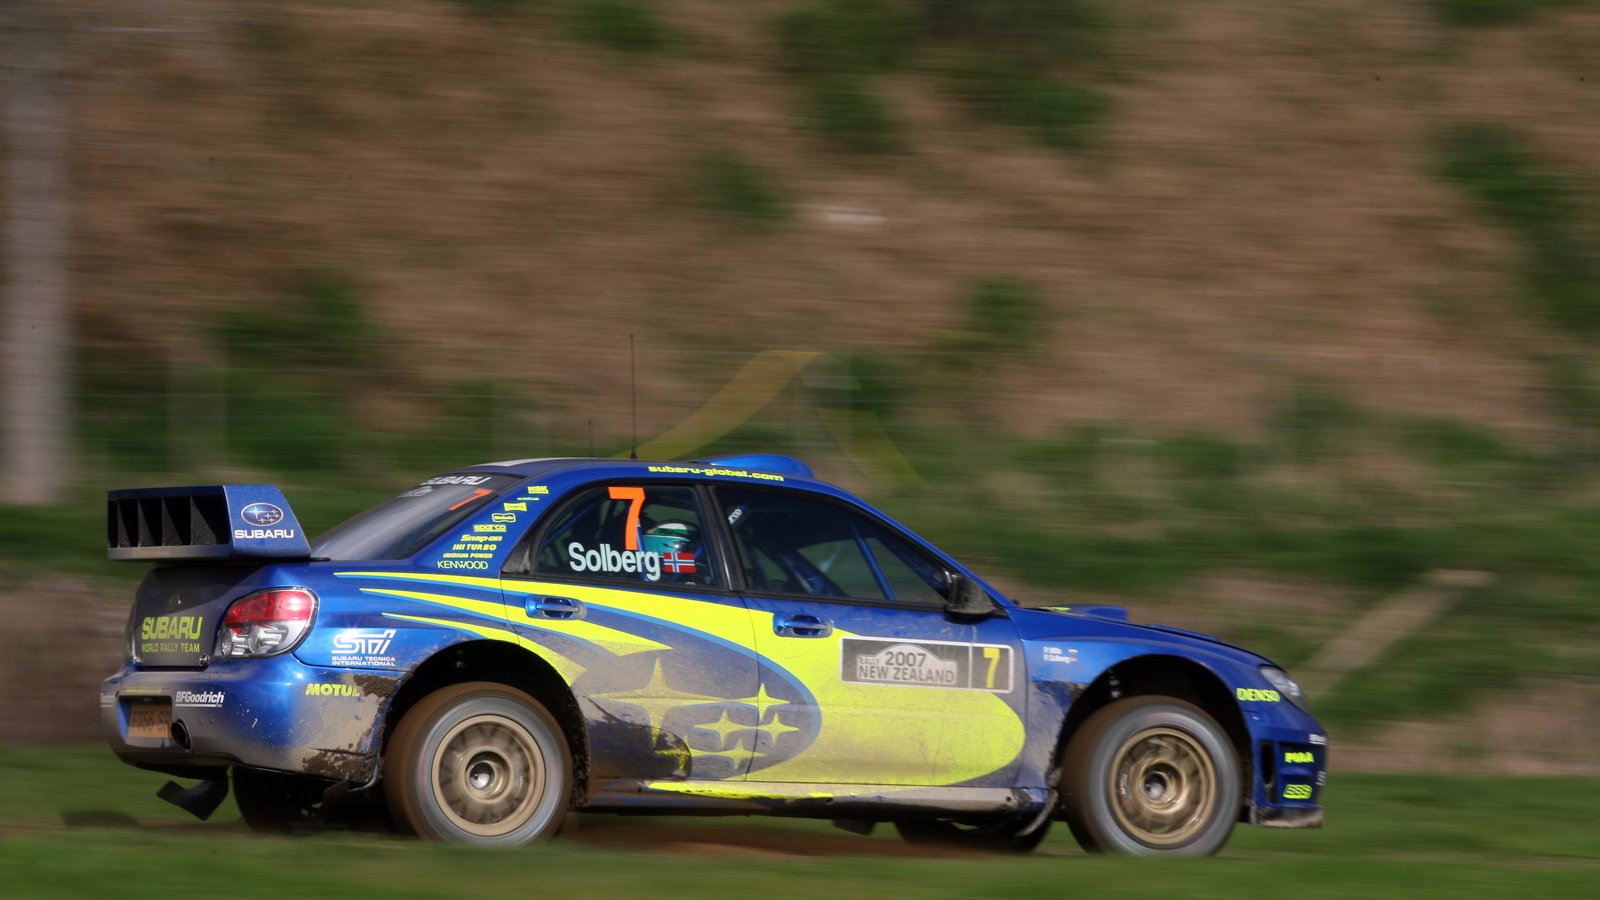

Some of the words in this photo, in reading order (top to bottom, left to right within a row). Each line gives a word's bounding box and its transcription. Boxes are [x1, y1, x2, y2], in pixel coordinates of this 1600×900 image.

[648, 465, 785, 482] subaru-global.com
[448, 488, 493, 511] 7
[608, 486, 646, 551] 7
[234, 529, 294, 539] SUBARU
[460, 534, 503, 543] Snap-on
[437, 560, 489, 570] KENWOOD
[568, 542, 662, 581] Solberg
[141, 616, 203, 640] SUBARU
[160, 643, 179, 653] RALLY
[181, 643, 201, 653] TEAM
[858, 657, 881, 666] RALLY
[885, 650, 927, 668] 2007
[859, 665, 890, 680] NEW
[893, 667, 955, 684] ZEALAND
[983, 647, 1001, 689] 7
[175, 690, 224, 703] BFGoodrich
[1236, 688, 1281, 703] DENSO
